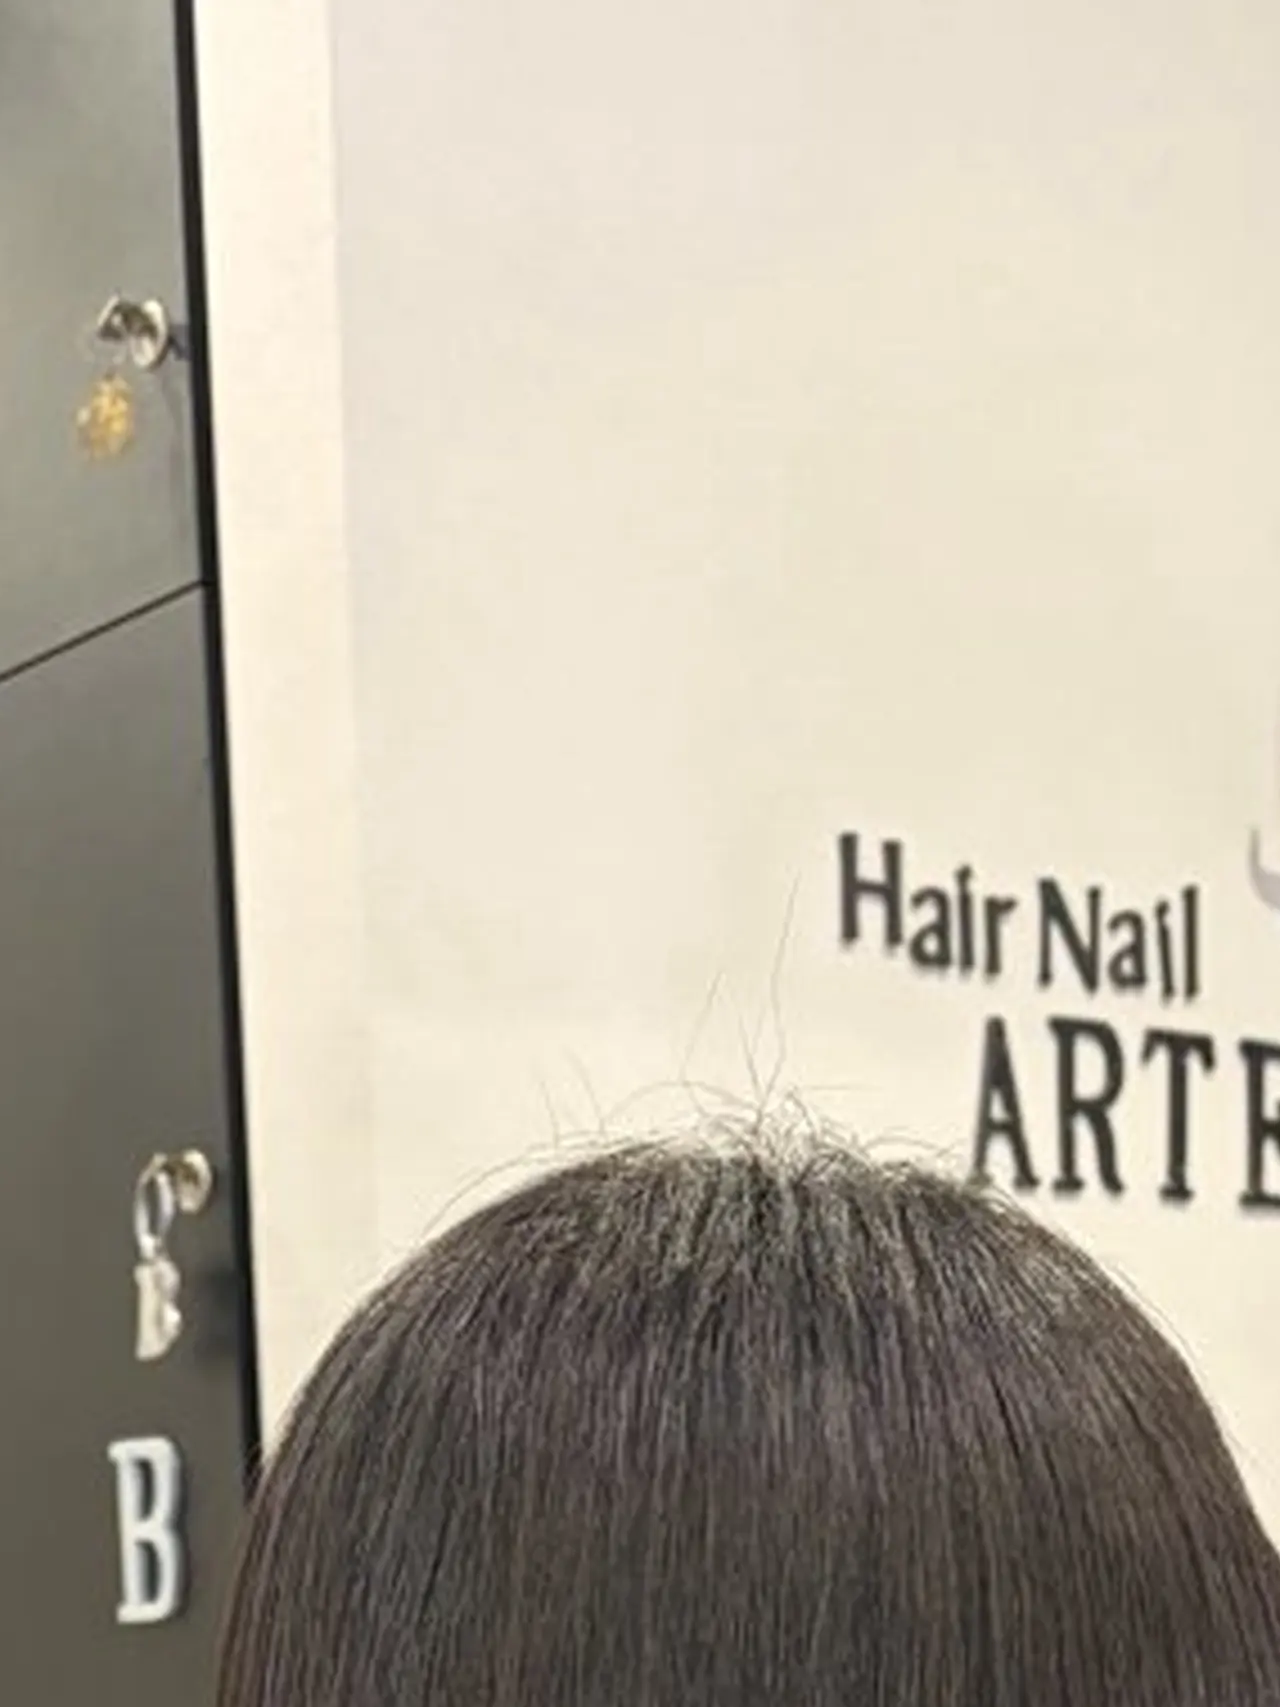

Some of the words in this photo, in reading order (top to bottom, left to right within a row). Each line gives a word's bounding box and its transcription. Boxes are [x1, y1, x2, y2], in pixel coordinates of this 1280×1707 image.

[837, 831, 1017, 979] Hair
[1036, 876, 1199, 1002] Nail
[108, 1435, 182, 1625] B
